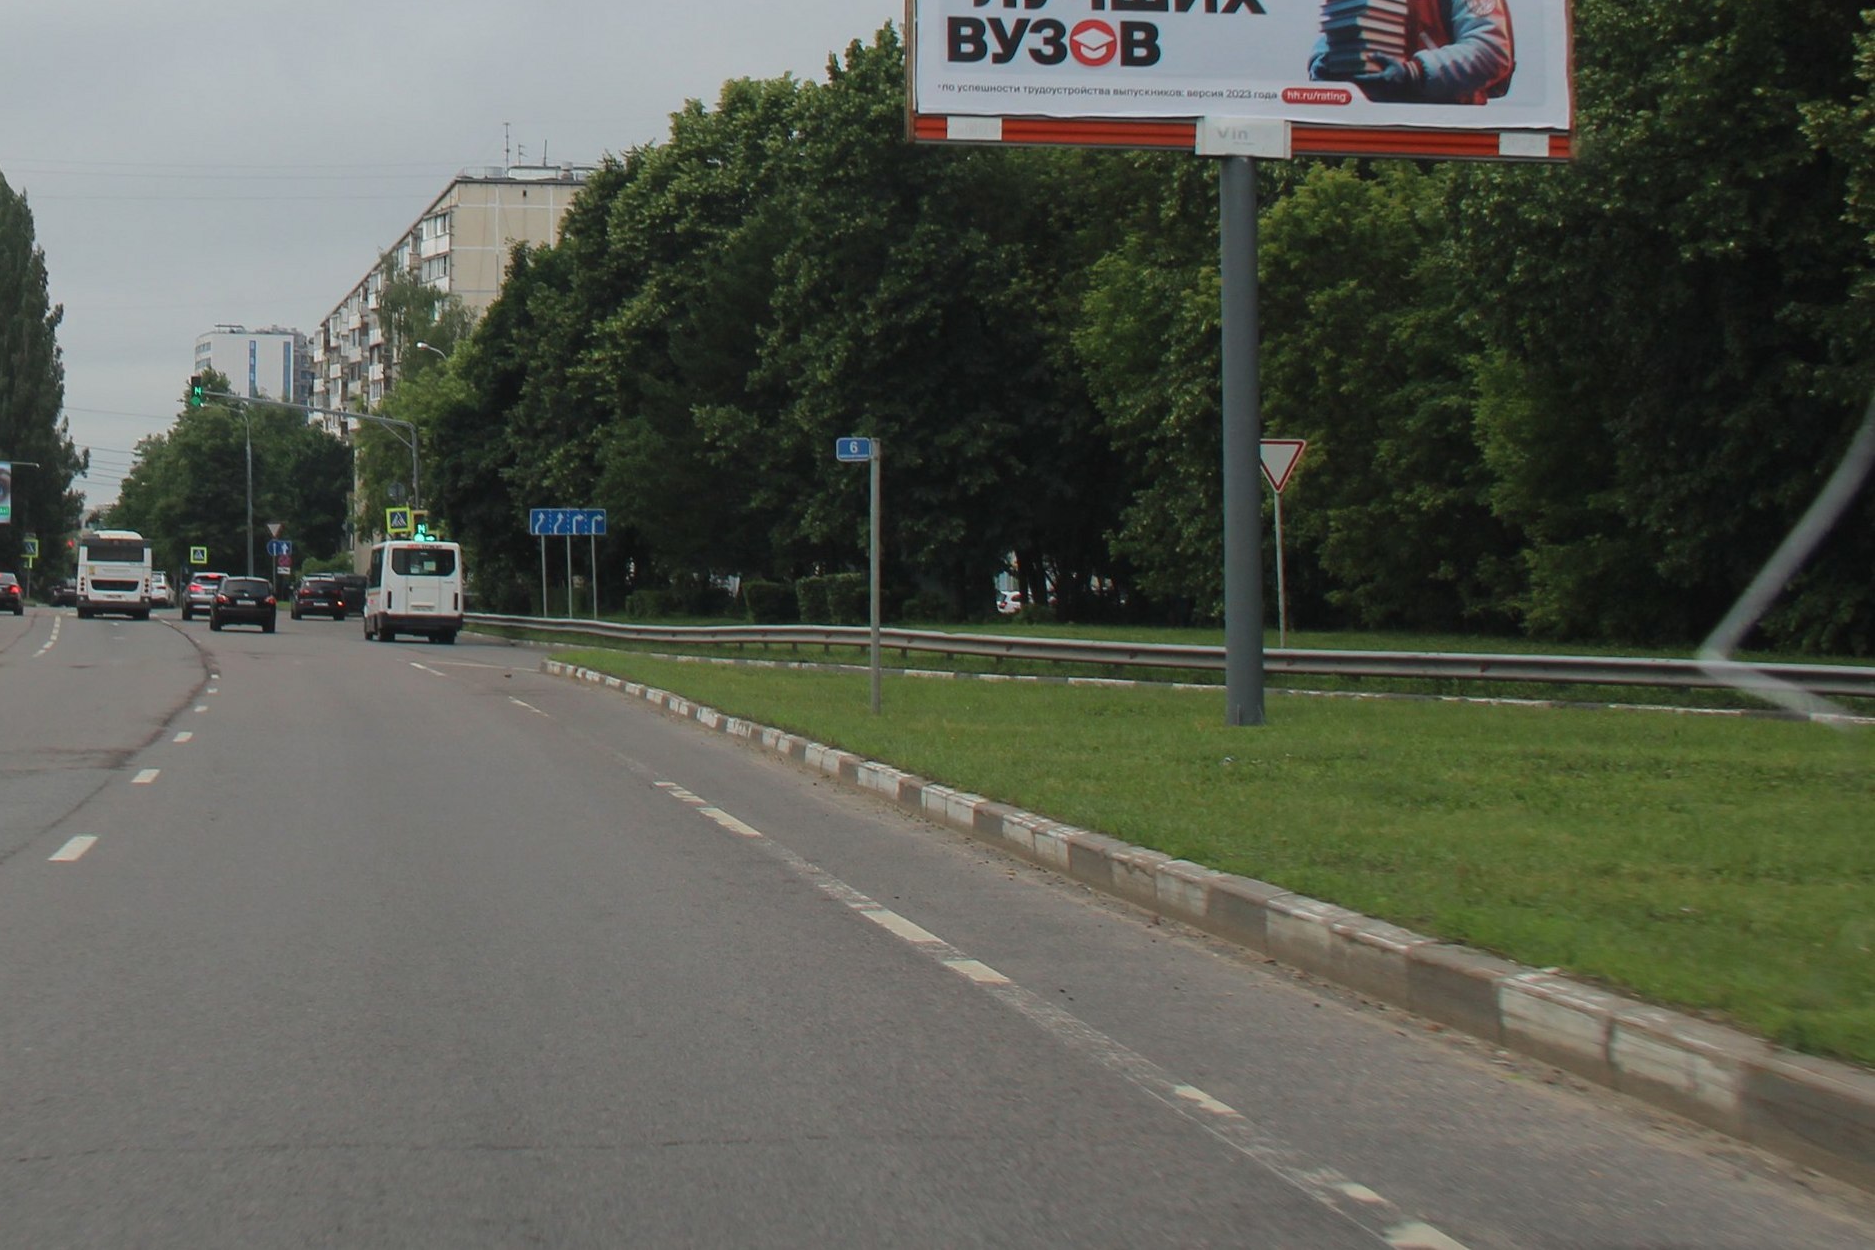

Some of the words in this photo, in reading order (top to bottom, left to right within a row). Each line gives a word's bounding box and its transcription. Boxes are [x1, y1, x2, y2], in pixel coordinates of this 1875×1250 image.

[946, 16, 1162, 67] ВУЗОВ
[957, 83, 1021, 94] успешности
[1023, 84, 1111, 97] трудоустройства
[1112, 87, 1184, 98] выпускников:
[1186, 89, 1224, 99] версия
[1226, 88, 1252, 99] 2023
[1253, 91, 1278, 101] года
[1287, 89, 1347, 104] hh.ru/rating
[849, 440, 859, 454] 6
